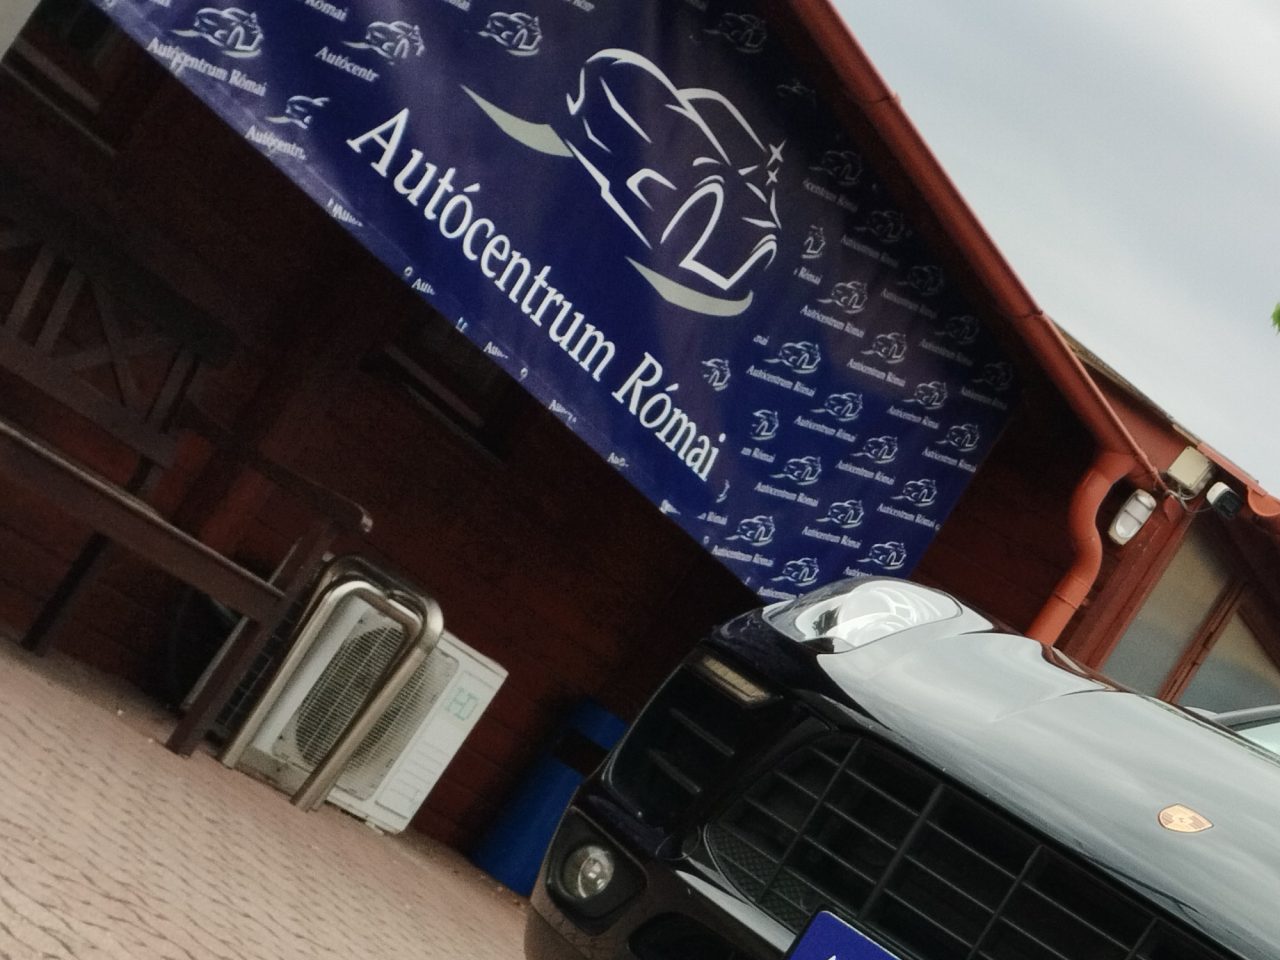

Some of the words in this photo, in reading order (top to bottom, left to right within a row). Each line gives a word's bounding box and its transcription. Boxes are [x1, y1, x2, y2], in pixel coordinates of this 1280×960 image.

[229, 69, 268, 97] Római
[346, 107, 616, 382] Autócentrum
[611, 351, 727, 482] Római
